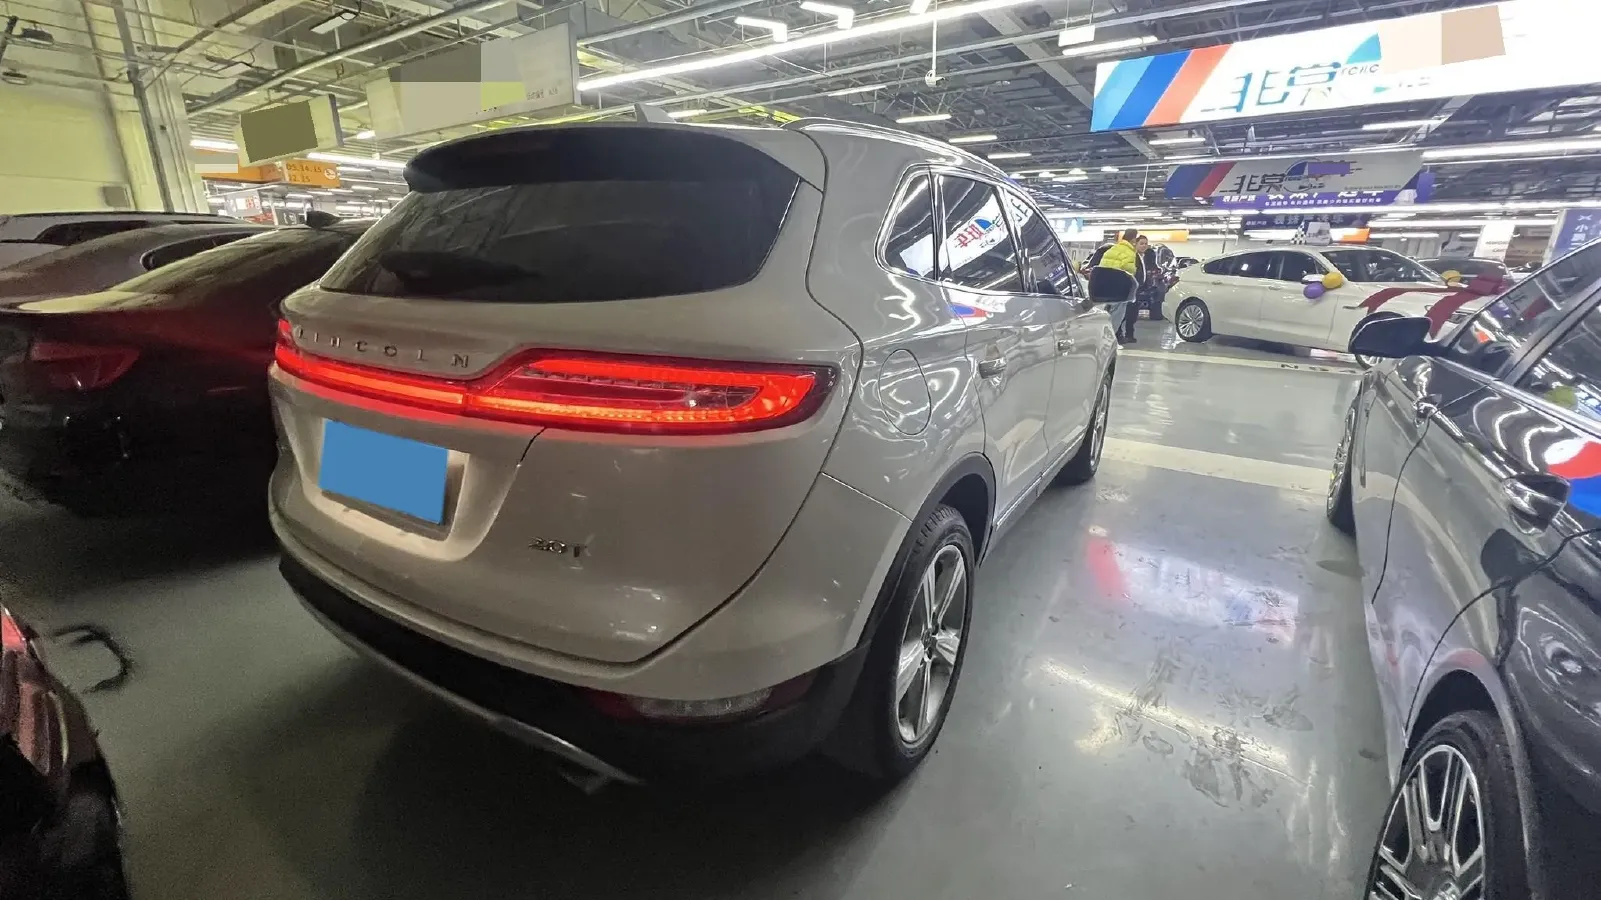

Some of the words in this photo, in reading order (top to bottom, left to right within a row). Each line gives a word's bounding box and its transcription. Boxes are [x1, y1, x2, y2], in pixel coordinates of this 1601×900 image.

[1200, 61, 1342, 112] 非常
[1219, 172, 1286, 194] 非常
[297, 327, 470, 369] LINCOLN
